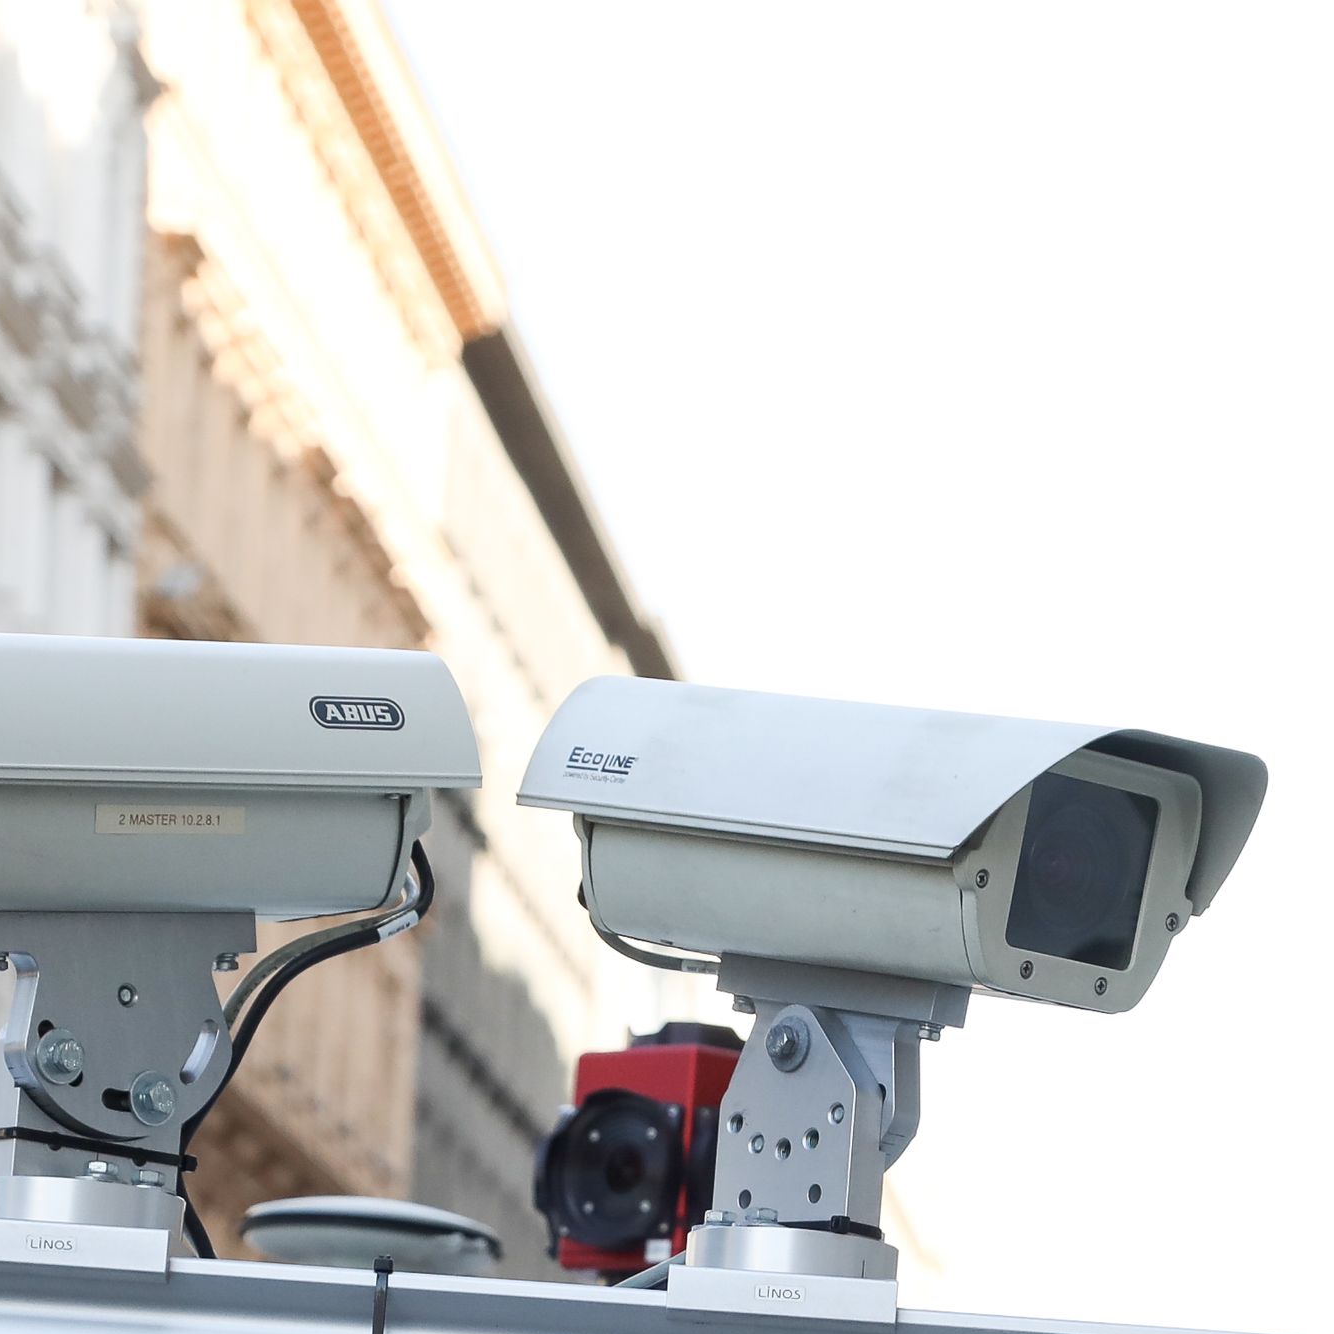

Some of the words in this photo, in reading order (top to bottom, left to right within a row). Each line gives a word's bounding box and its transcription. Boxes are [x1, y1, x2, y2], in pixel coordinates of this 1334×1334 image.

[325, 703, 393, 722] ABUS
[119, 814, 126, 826] 2
[129, 814, 177, 826] MASTER
[182, 814, 221, 826] 10.2.8.1
